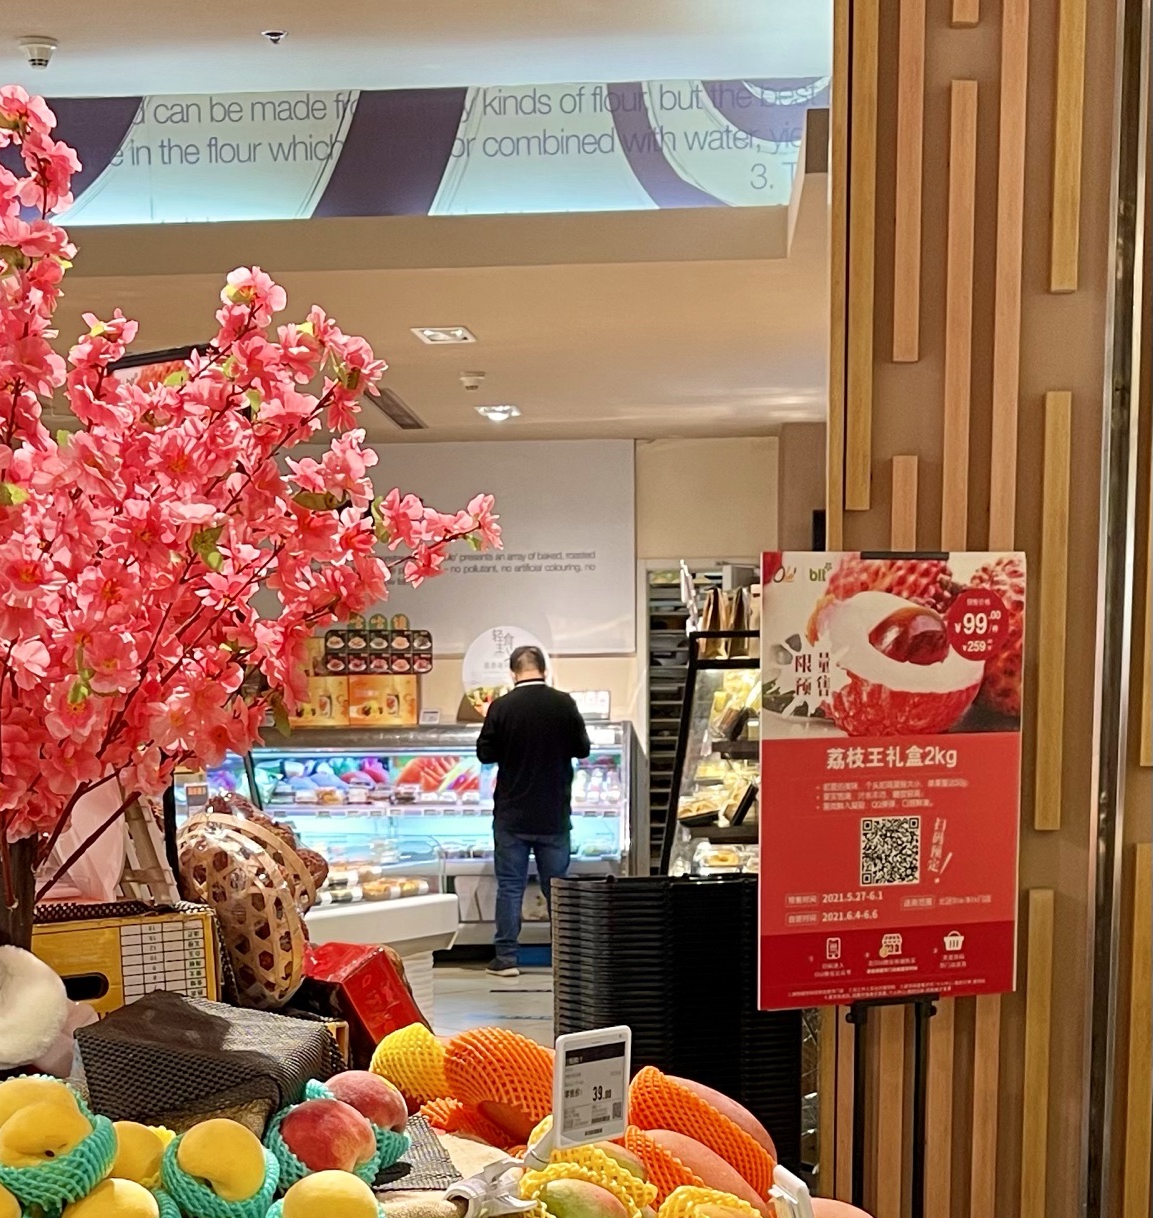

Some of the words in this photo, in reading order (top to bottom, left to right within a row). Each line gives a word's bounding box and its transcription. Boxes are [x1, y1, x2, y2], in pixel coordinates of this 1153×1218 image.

[153, 102, 201, 124] can
[209, 96, 243, 123] be
[250, 93, 327, 122] made
[483, 88, 551, 115] kinds
[559, 86, 586, 114] of
[659, 84, 703, 111] but
[710, 83, 751, 110] the
[130, 139, 152, 166] in
[159, 137, 200, 165] the
[207, 136, 261, 164] flour
[268, 133, 346, 162] which
[483, 128, 615, 158] combined
[622, 126, 675, 155] with
[685, 125, 761, 153] water,
[750, 163, 774, 190] 3.
[459, 553, 494, 562] presents
[507, 553, 526, 562] array
[528, 551, 536, 560] of
[537, 551, 563, 560] baked,
[463, 564, 499, 574] pollutant,
[514, 563, 543, 572] artificial
[545, 563, 583, 573] colouring,
[584, 563, 596, 571] no
[795, 652, 830, 673] 限量
[795, 675, 830, 697] 预售
[826, 745, 958, 770] 荔枝王礼盒2kg
[821, 890, 884, 904] 2021.5.27-6.1
[821, 909, 879, 923] 2021.6.4-6.6
